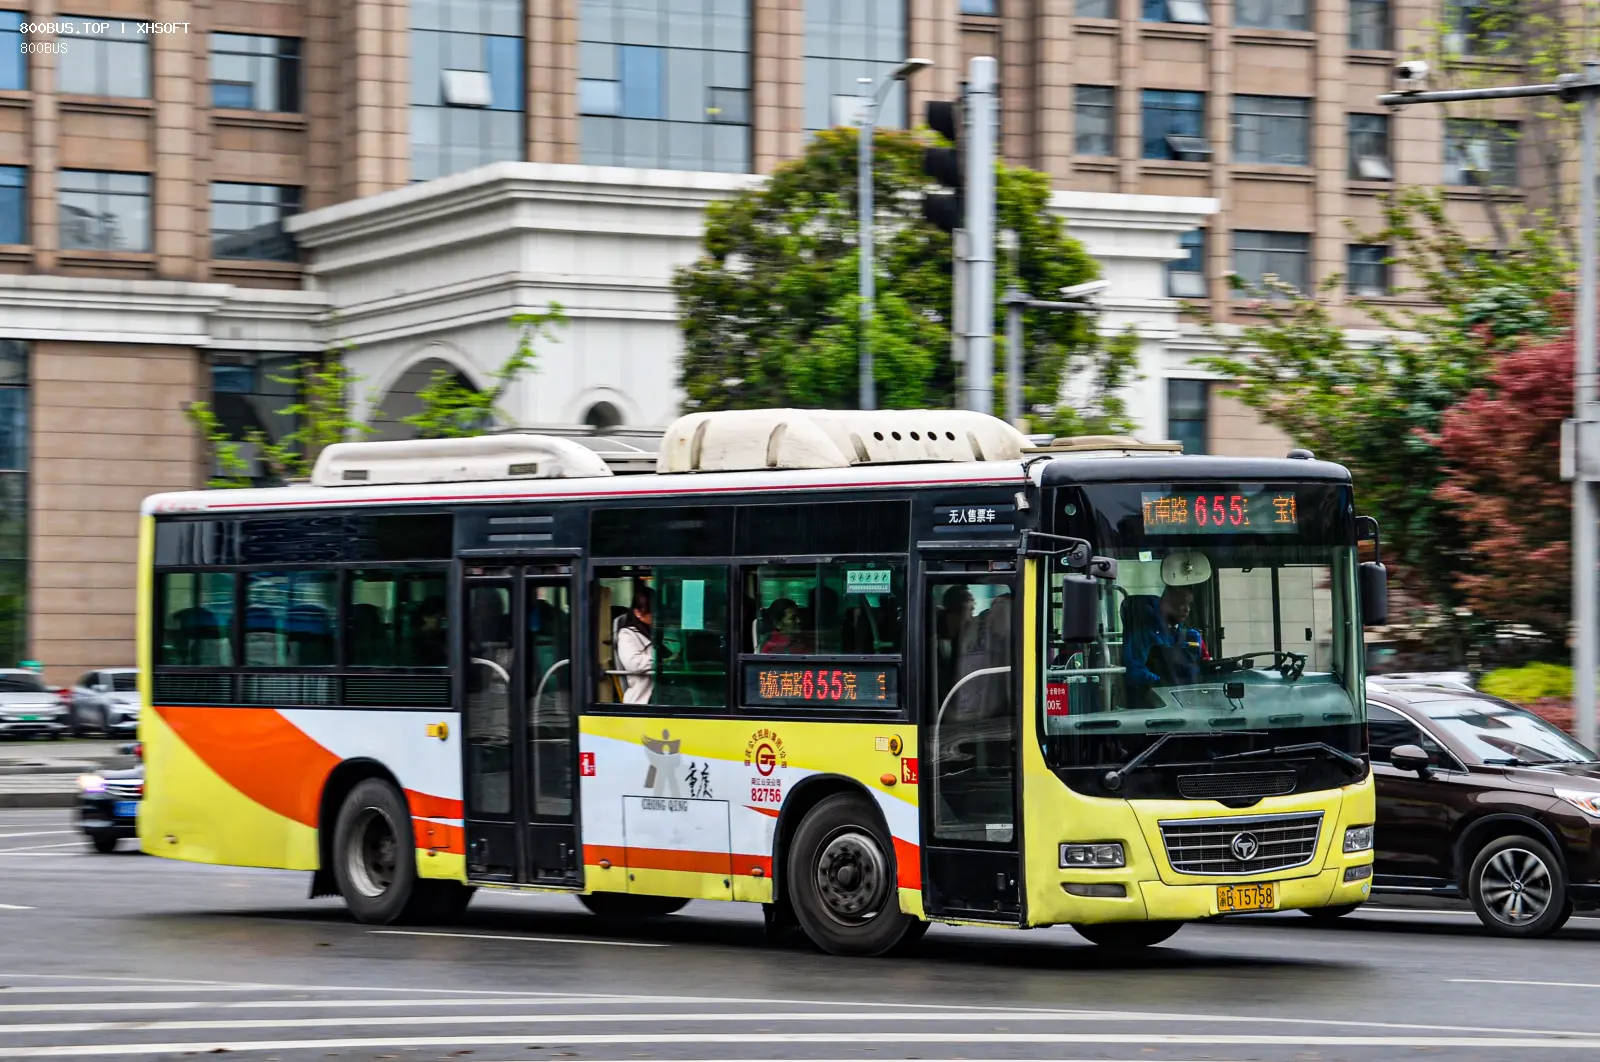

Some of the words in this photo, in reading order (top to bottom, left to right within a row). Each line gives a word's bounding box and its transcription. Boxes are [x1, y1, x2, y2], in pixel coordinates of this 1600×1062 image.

[948, 508, 996, 524] 无人售票车
[1194, 495, 1243, 526] 655
[802, 670, 842, 700] 655
[751, 788, 782, 802] 82756
